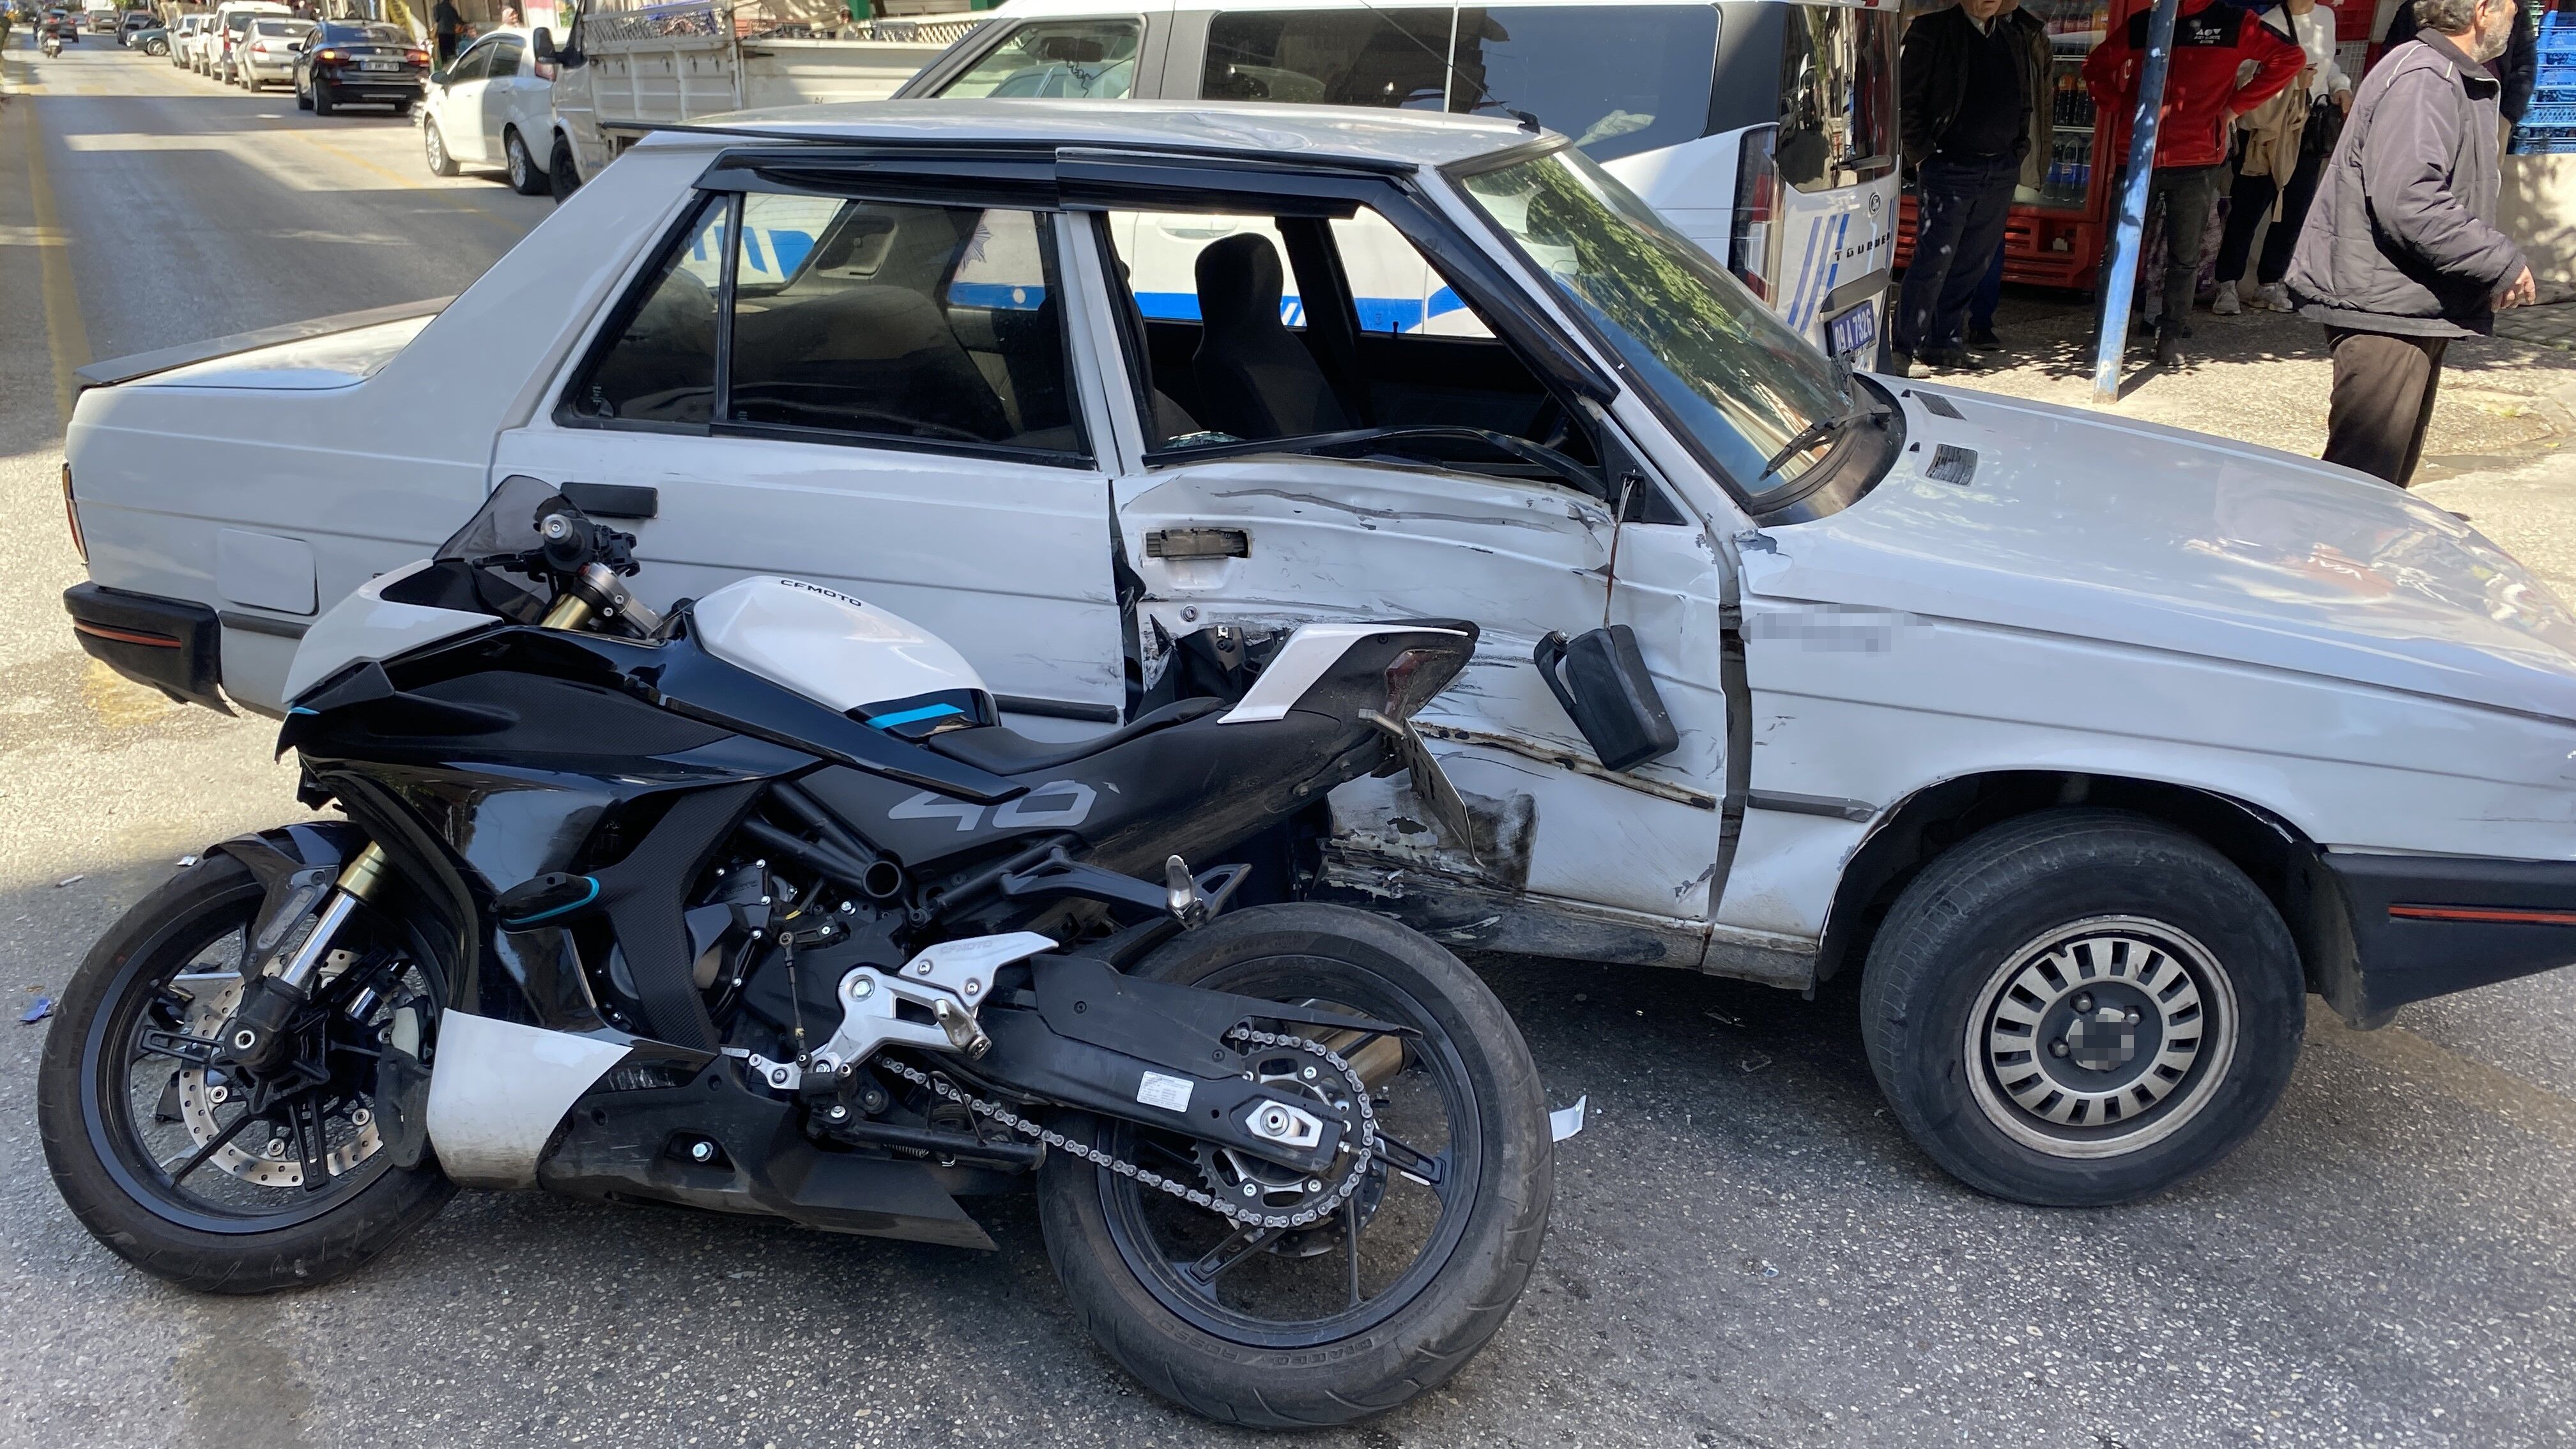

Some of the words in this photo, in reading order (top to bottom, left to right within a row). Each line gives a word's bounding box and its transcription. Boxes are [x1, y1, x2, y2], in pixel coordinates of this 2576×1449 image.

[1835, 323, 1846, 351] 09
[1846, 319, 1853, 348] A
[1852, 308, 1873, 344] 7326
[781, 579, 862, 607] CFMOTO
